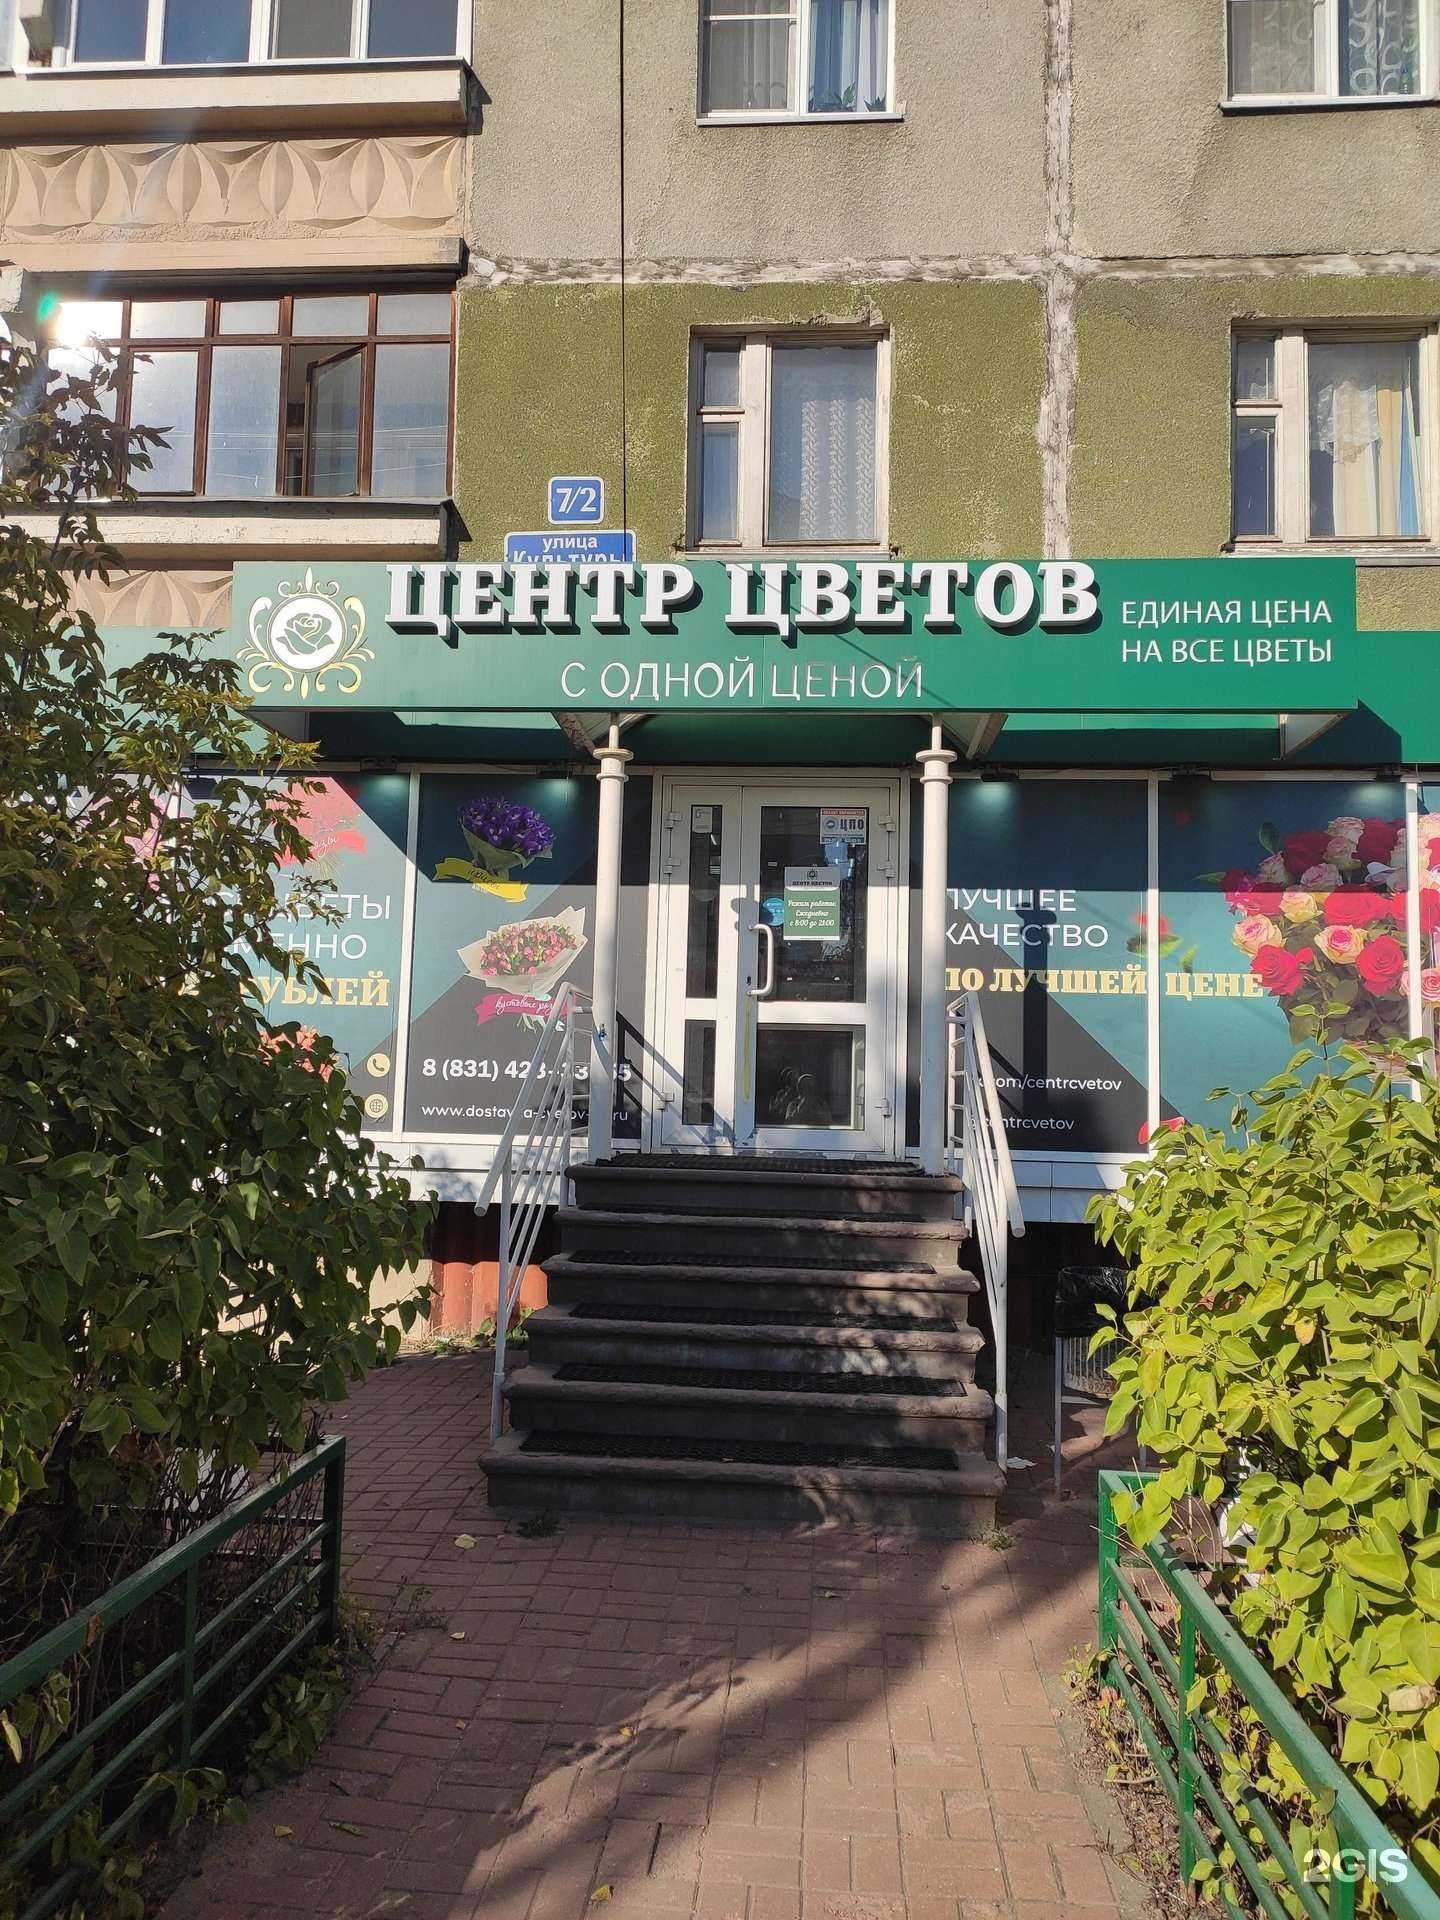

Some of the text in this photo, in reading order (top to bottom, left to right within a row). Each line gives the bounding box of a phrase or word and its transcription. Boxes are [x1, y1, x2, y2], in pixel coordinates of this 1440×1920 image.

[556, 486, 597, 514] 7/2
[543, 536, 598, 553] улица
[385, 562, 1098, 637] ЦЕНТР ЦВЕТОВ
[1122, 600, 1333, 629] ЕДИНАЯ ЦЕНА
[1122, 639, 1332, 667] НА ВСЕ ЦВЕТЫ
[560, 656, 923, 701] С ОДНОЙ ЦЕНОЙ
[840, 818, 865, 831] ЦПО
[989, 963, 1147, 995] ЛУЧШЕЙ
[1165, 973, 1265, 1001] ЦЕНЕ
[421, 1058, 436, 1077] 8
[442, 1060, 498, 1081] (831)
